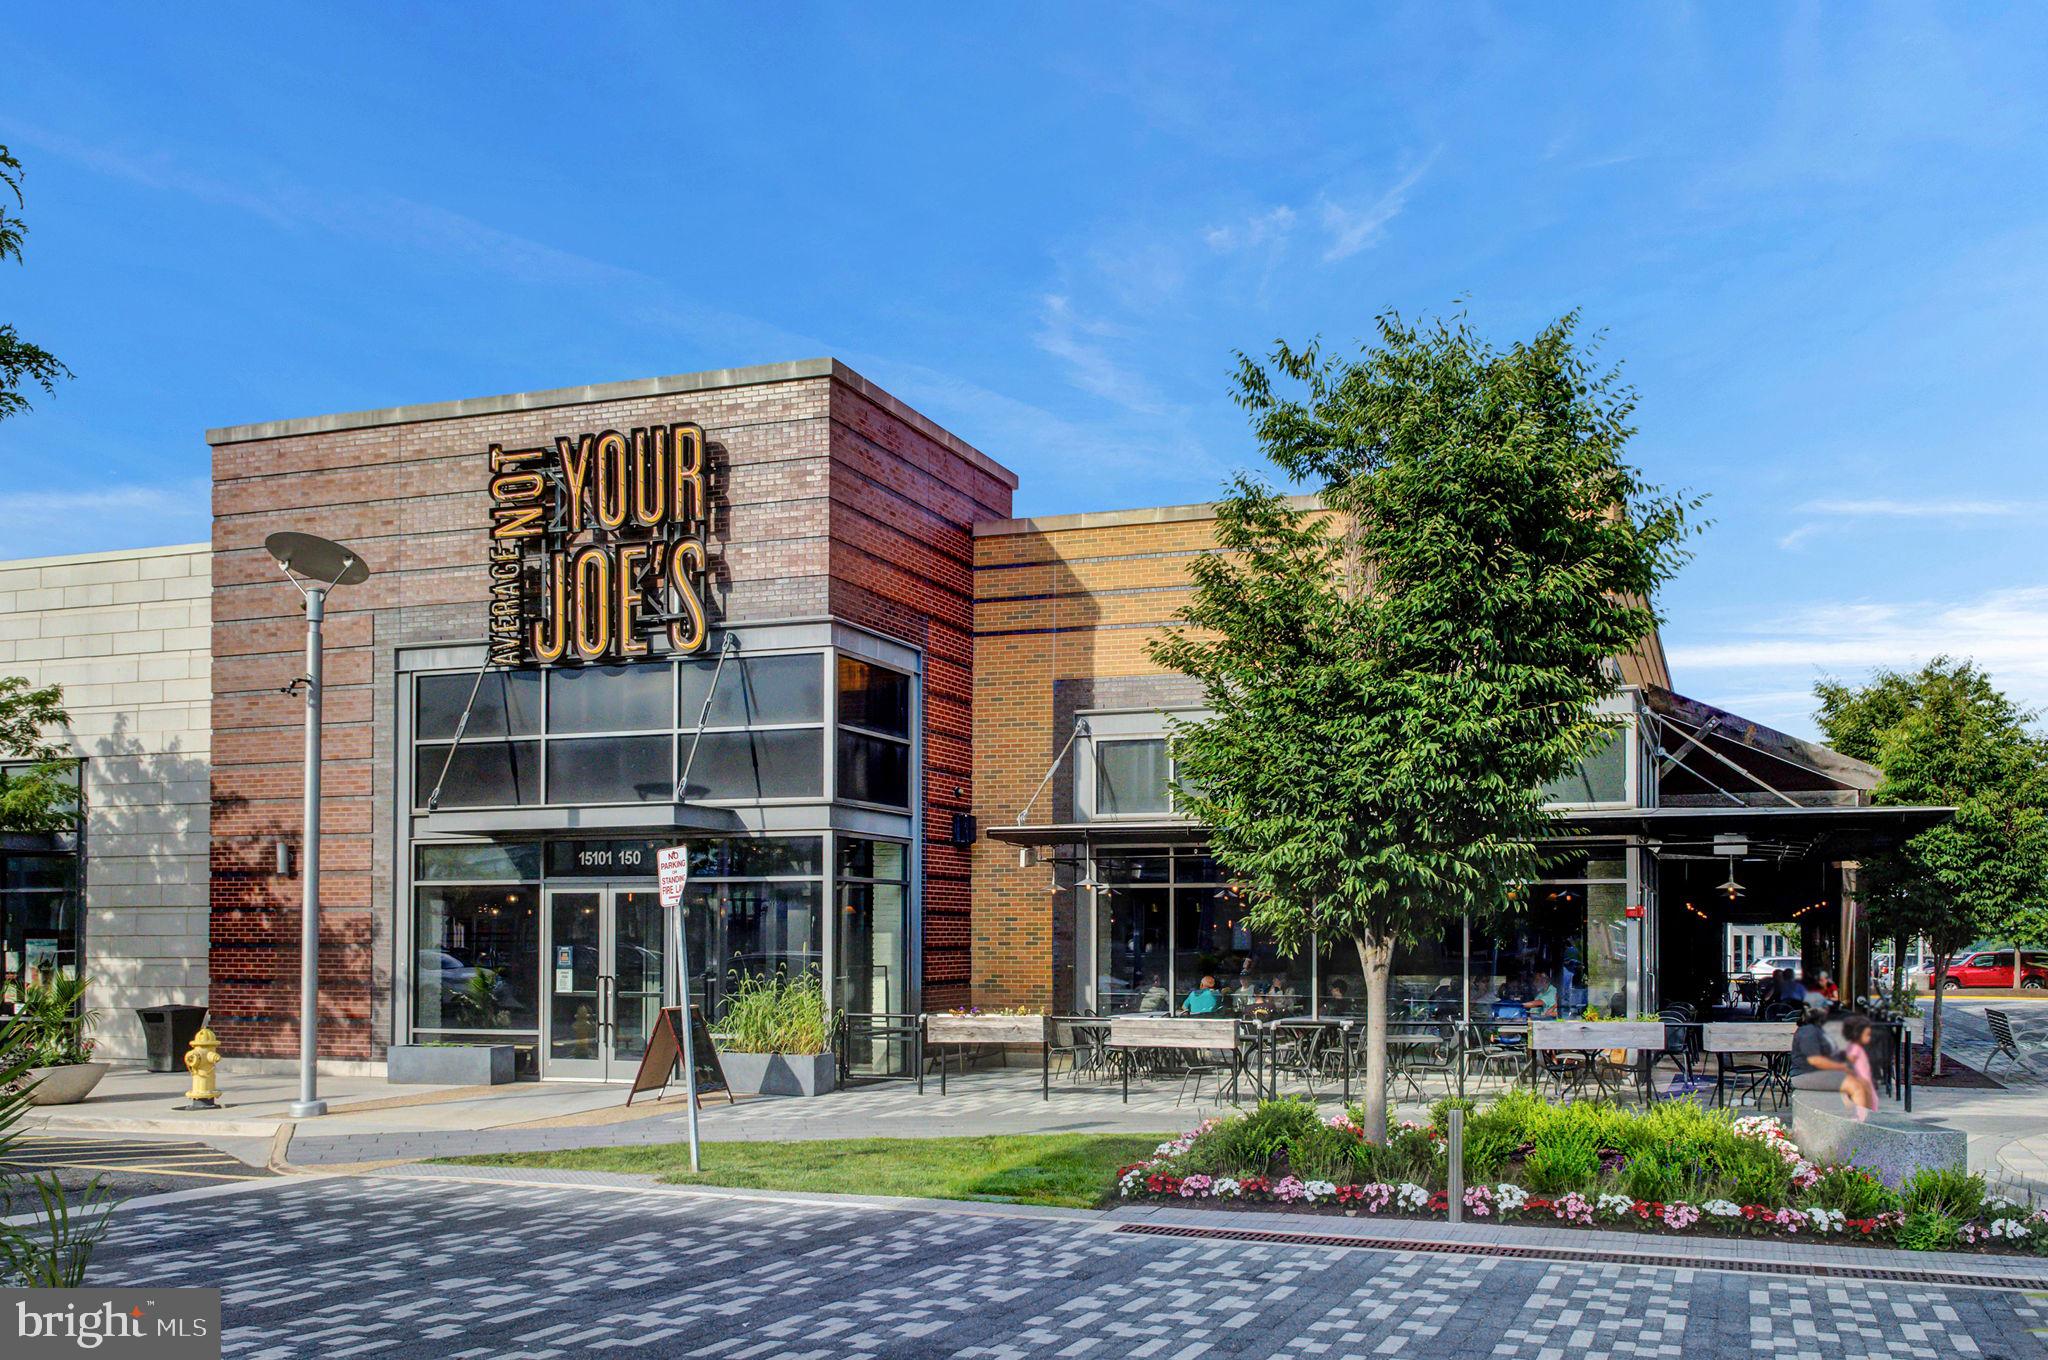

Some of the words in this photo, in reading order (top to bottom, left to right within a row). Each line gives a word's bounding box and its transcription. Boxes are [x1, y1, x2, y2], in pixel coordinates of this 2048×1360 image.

[489, 443, 545, 539] NOT
[555, 422, 705, 532] YOUR
[489, 546, 523, 666] AVERAGE
[529, 536, 706, 662] JOE'S
[578, 850, 613, 866] 15101
[618, 850, 641, 865] 150
[660, 859, 686, 870] PARKING
[667, 850, 679, 860] NO
